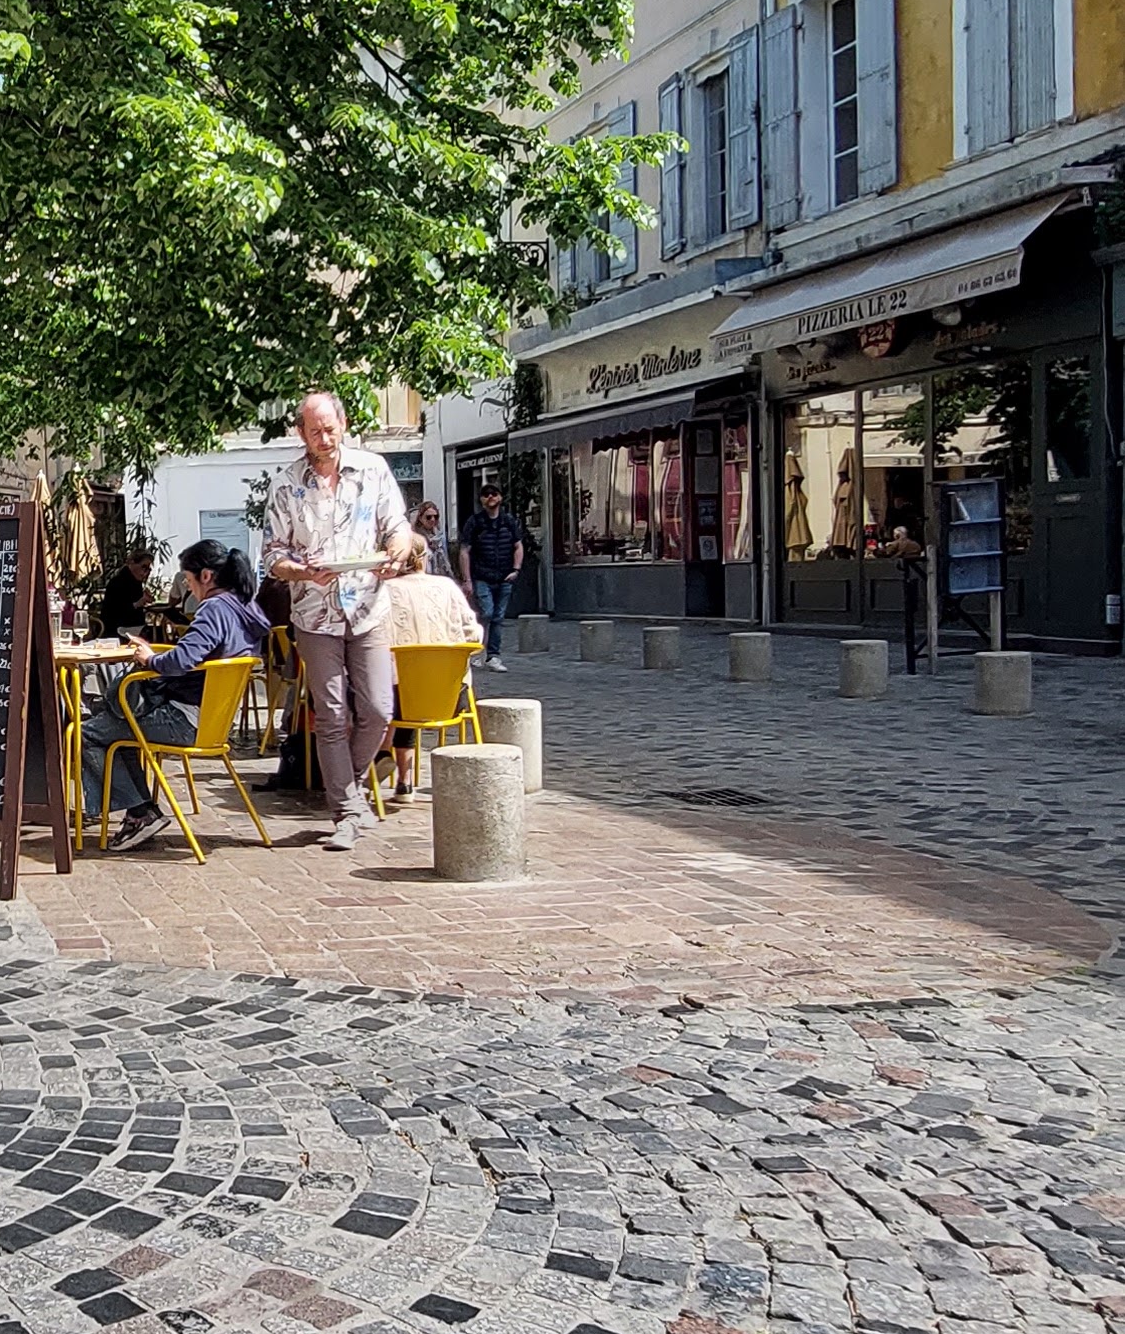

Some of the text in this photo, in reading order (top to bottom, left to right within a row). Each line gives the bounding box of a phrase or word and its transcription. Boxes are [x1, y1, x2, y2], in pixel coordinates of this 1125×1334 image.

[797, 289, 908, 335] PIZZERIA LE 22
[867, 326, 884, 342] 22
[640, 345, 702, 381] Moderne
